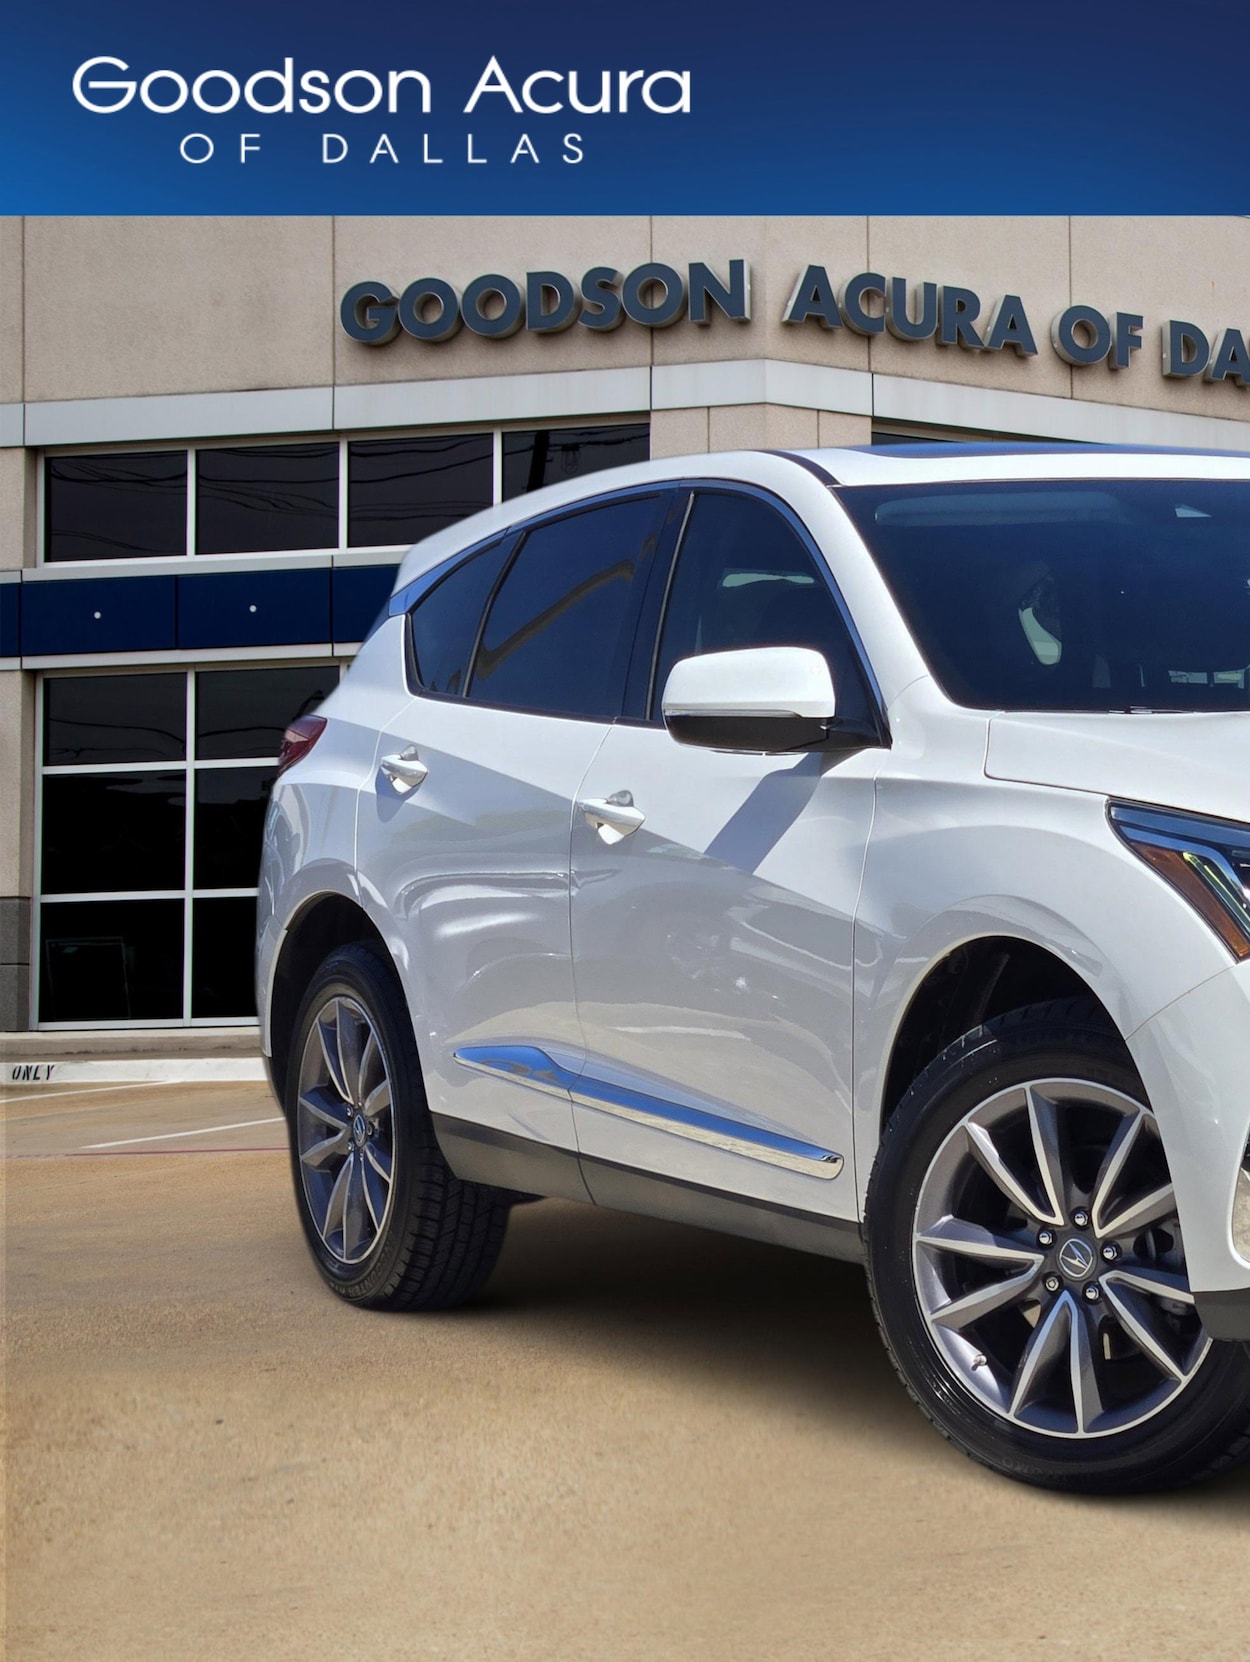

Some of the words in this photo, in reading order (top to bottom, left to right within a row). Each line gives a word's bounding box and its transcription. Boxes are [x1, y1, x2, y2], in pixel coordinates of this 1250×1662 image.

[340, 259, 750, 346] GOODSON
[782, 264, 1037, 357] ACURA
[1051, 305, 1144, 369] OF
[12, 1065, 55, 1081] ONLY
